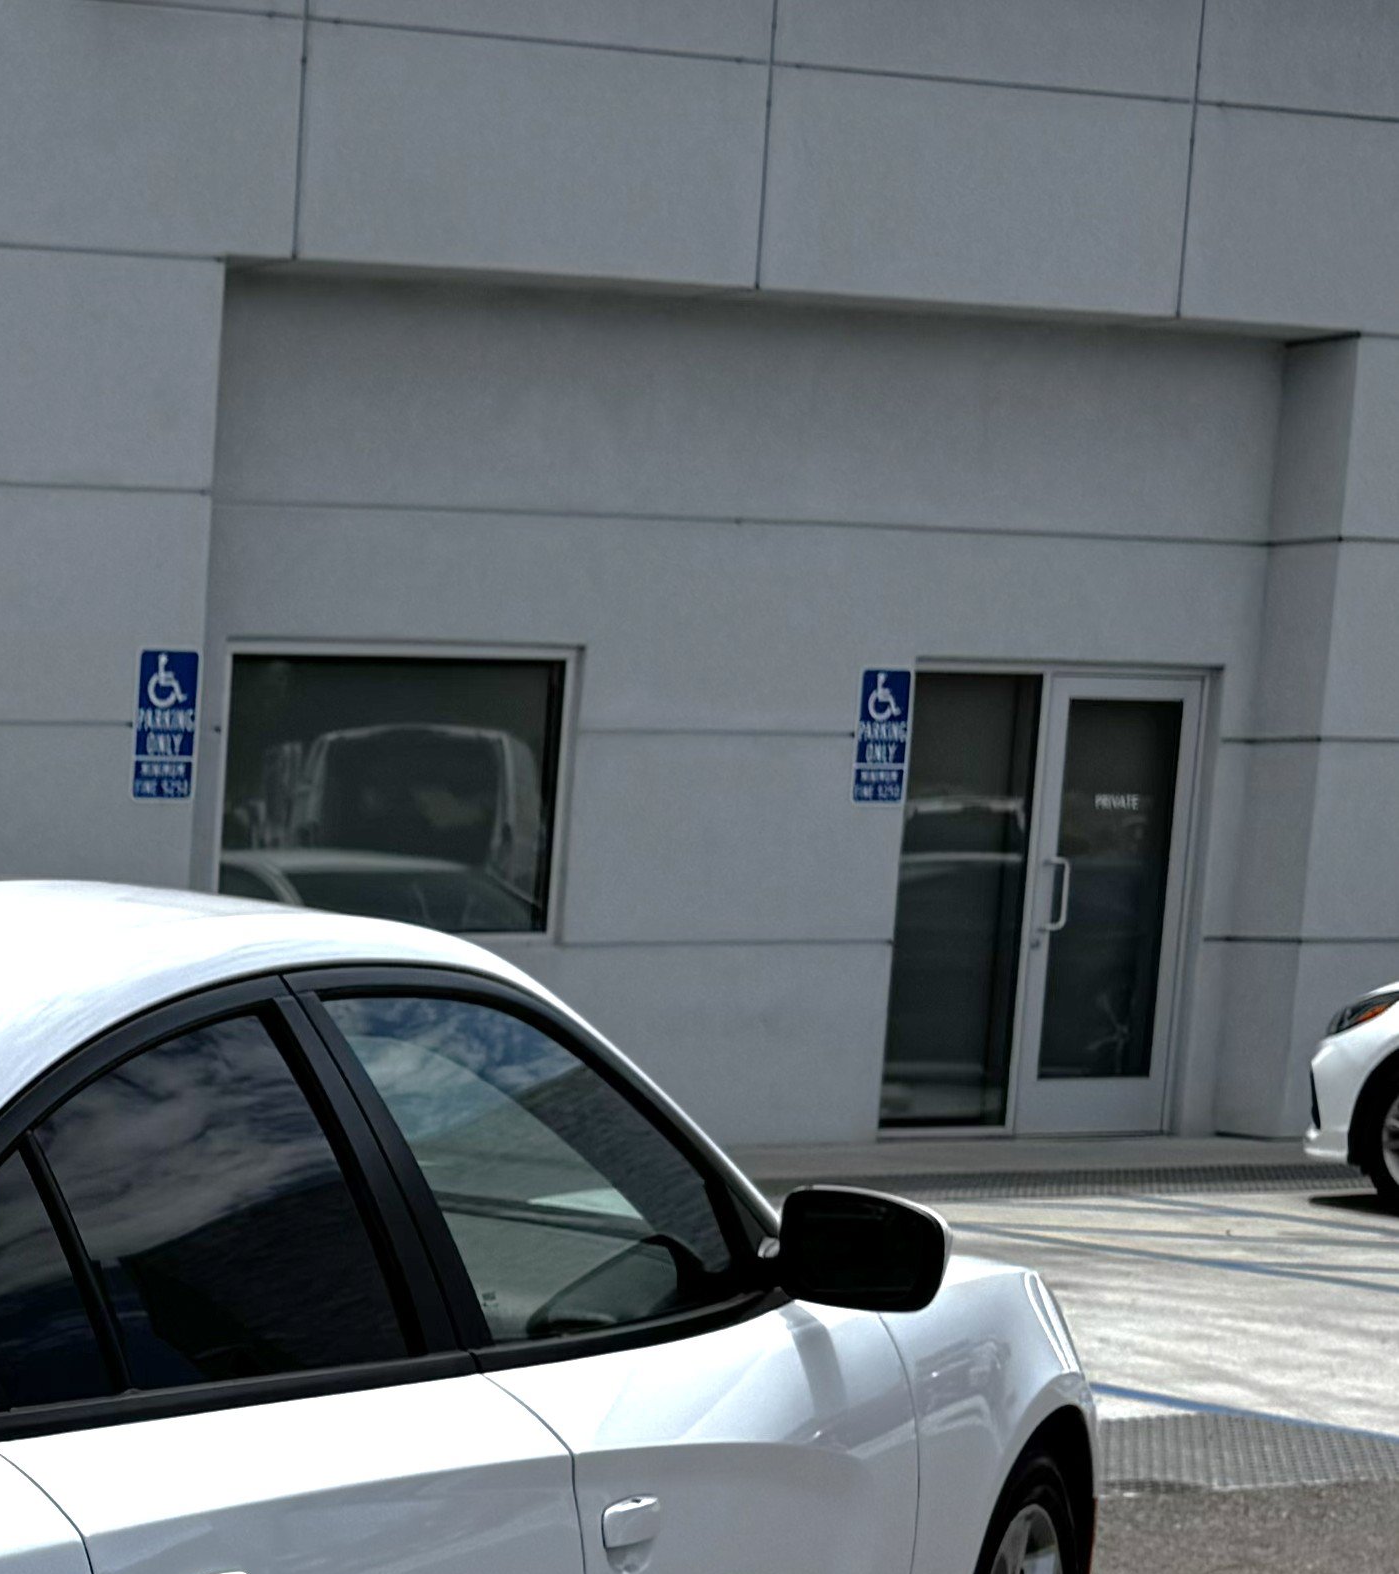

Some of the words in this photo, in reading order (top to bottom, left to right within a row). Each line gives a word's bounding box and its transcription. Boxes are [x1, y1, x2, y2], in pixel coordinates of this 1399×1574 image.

[137, 708, 195, 732] PARKING
[858, 720, 907, 742] PARKING
[146, 733, 183, 756] ONLY
[865, 743, 898, 763] ONLY
[1094, 793, 1140, 811] PRIVATE
